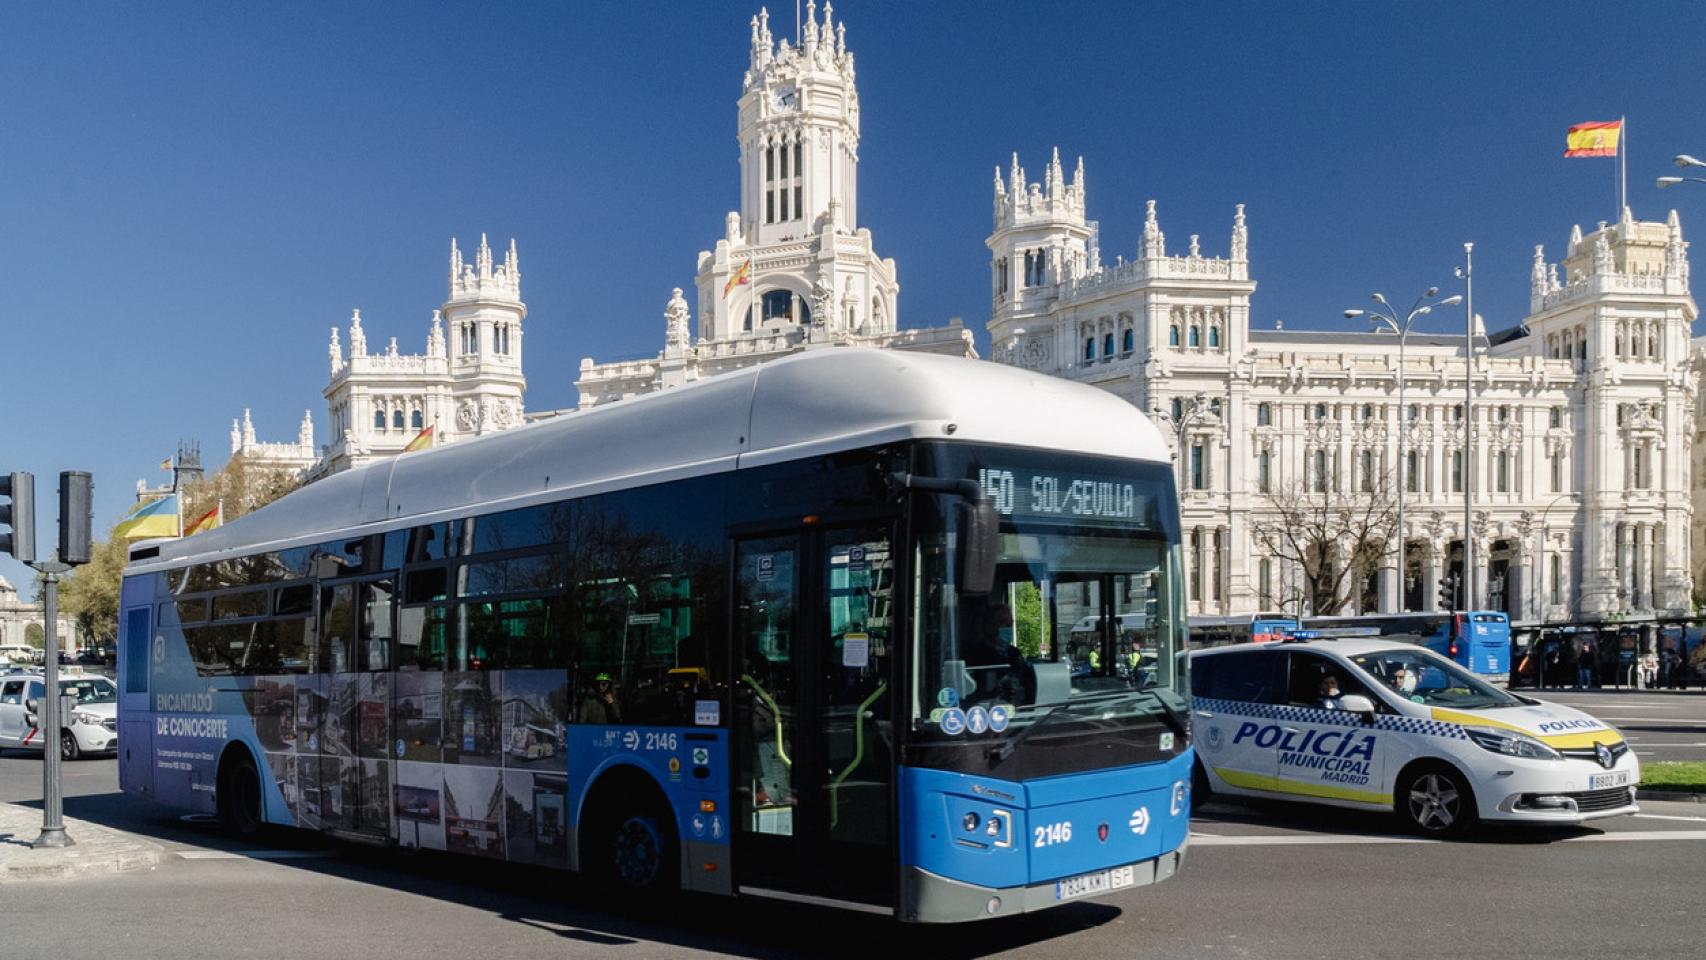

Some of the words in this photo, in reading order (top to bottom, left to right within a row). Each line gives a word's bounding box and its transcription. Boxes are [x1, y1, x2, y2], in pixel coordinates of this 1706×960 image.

[1031, 475, 1133, 517] SOL/SEVILLA
[157, 693, 213, 712] ENCANTADO
[157, 717, 169, 735] DE
[170, 718, 228, 739] CONOCERTE
[645, 732, 677, 750] 2146
[1232, 722, 1376, 760] POLICÍA
[1280, 752, 1370, 775] MUNICIPAL
[1321, 771, 1369, 785] MADRID
[1034, 821, 1072, 848] 2146
